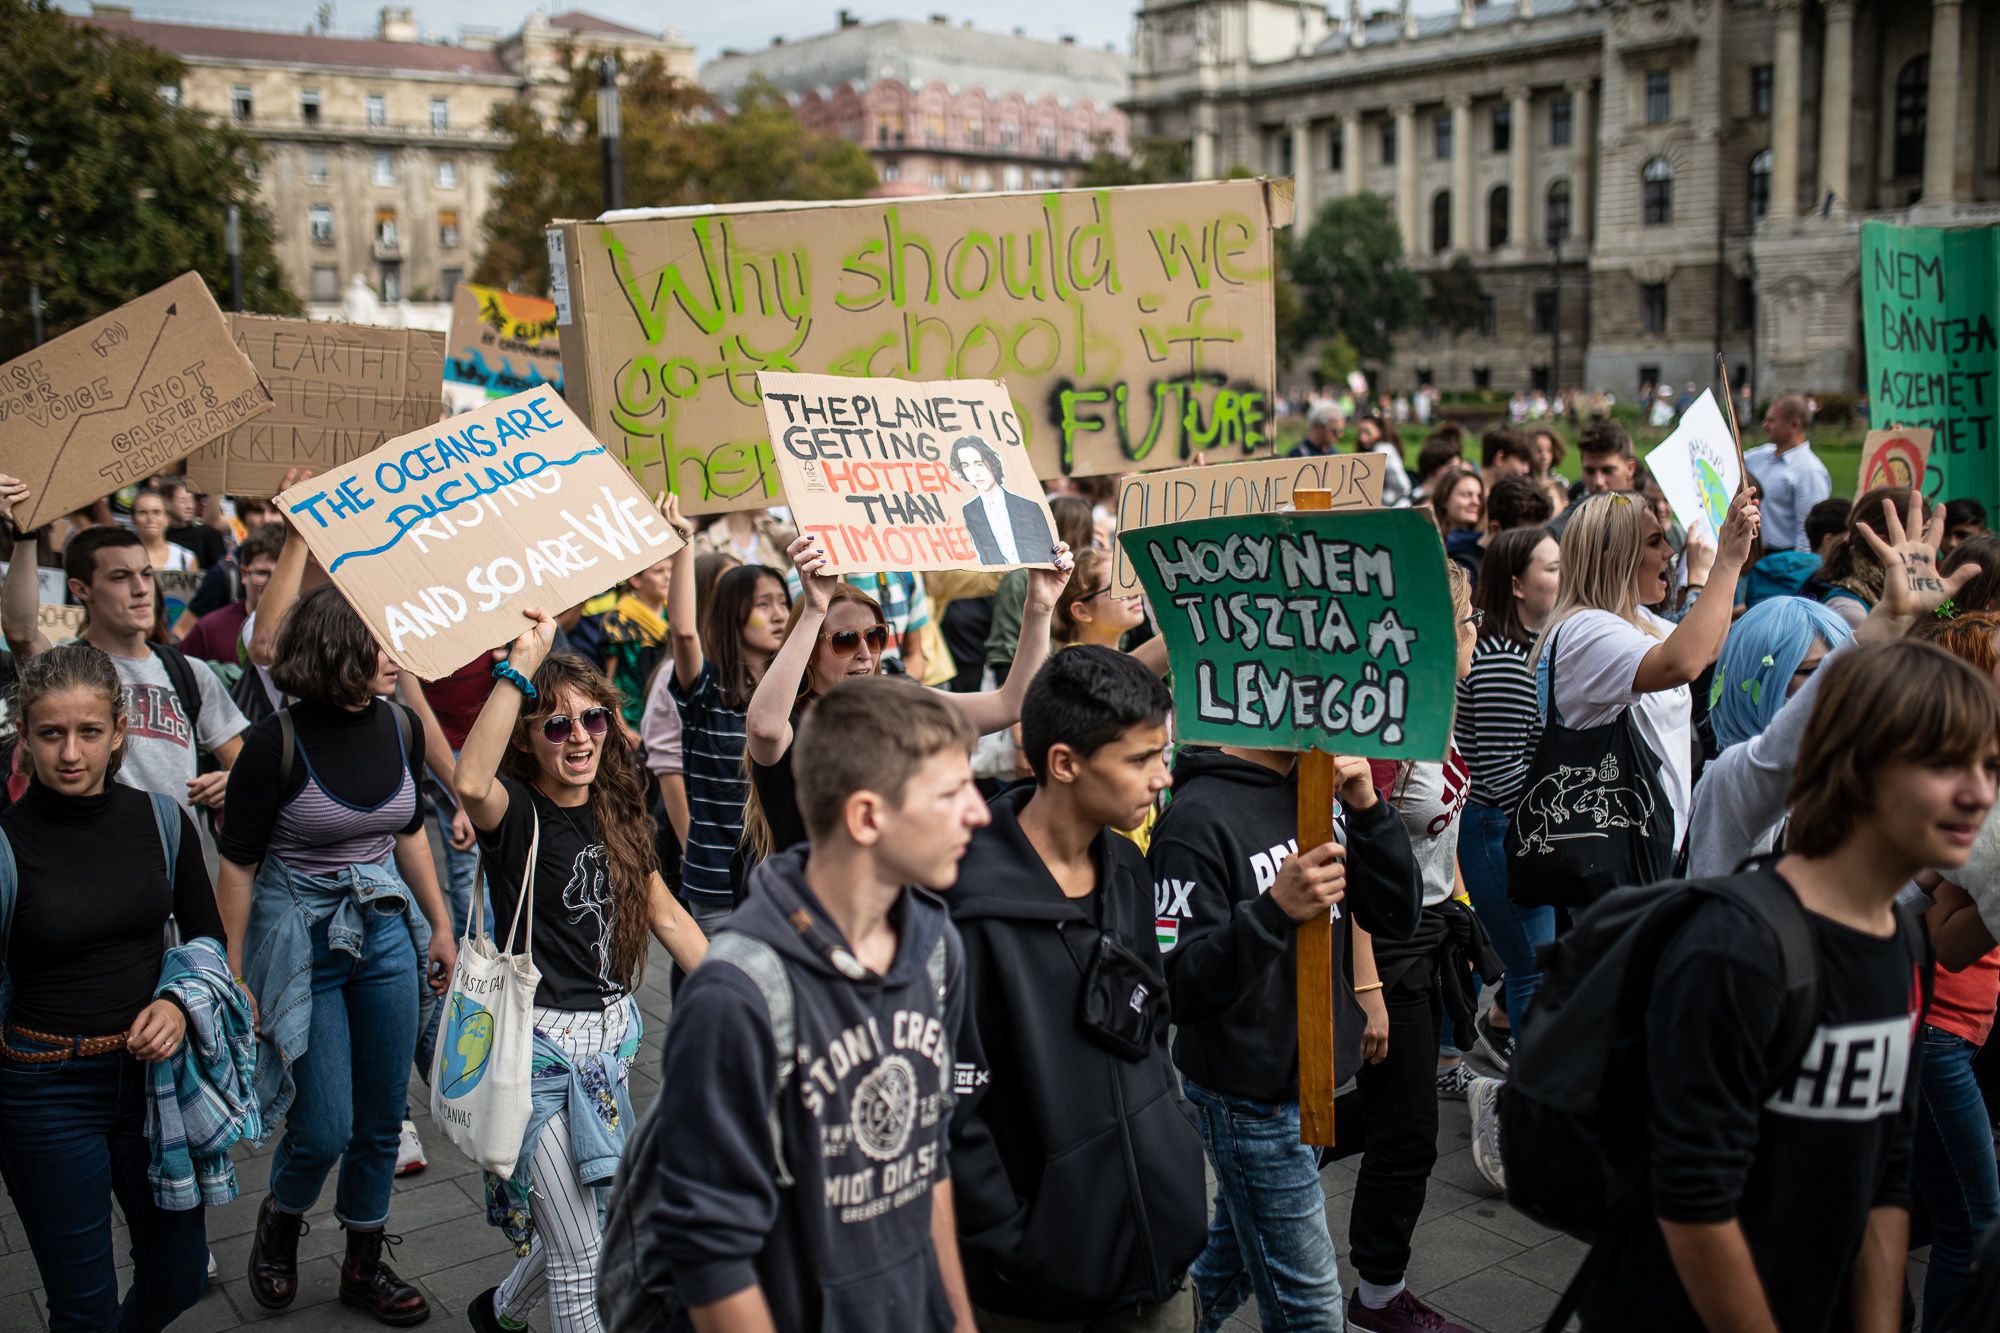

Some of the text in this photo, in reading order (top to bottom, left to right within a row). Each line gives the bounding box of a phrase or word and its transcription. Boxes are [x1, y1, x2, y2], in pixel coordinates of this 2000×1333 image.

[602, 214, 812, 362] Why
[834, 188, 1122, 313] should
[1146, 212, 1273, 292] we
[1875, 247, 1944, 304] NEM
[1881, 304, 1998, 354] BÁNTJA
[0, 359, 50, 396] ISE
[139, 360, 206, 414] NOT
[610, 355, 700, 437] go
[1138, 296, 1242, 378] if
[26, 375, 114, 429] VOICE
[262, 376, 432, 425] TTER THAN
[764, 393, 858, 427] THE
[850, 394, 984, 433] PLANET
[988, 409, 1021, 447] IS
[1052, 375, 1268, 475] FUTURE
[99, 383, 268, 484] TEMPERATURE
[291, 425, 388, 465] MINA
[783, 425, 941, 462] GETTING
[290, 397, 565, 528] THE OCEANS ARE
[820, 460, 962, 495] HOTTER
[845, 491, 947, 526] THAN
[383, 485, 671, 653] AND SO ARE WE
[1147, 530, 1397, 601] HOGY NEM
[1172, 592, 1419, 667] TISZTA A
[443, 1103, 472, 1129] CANVAS
